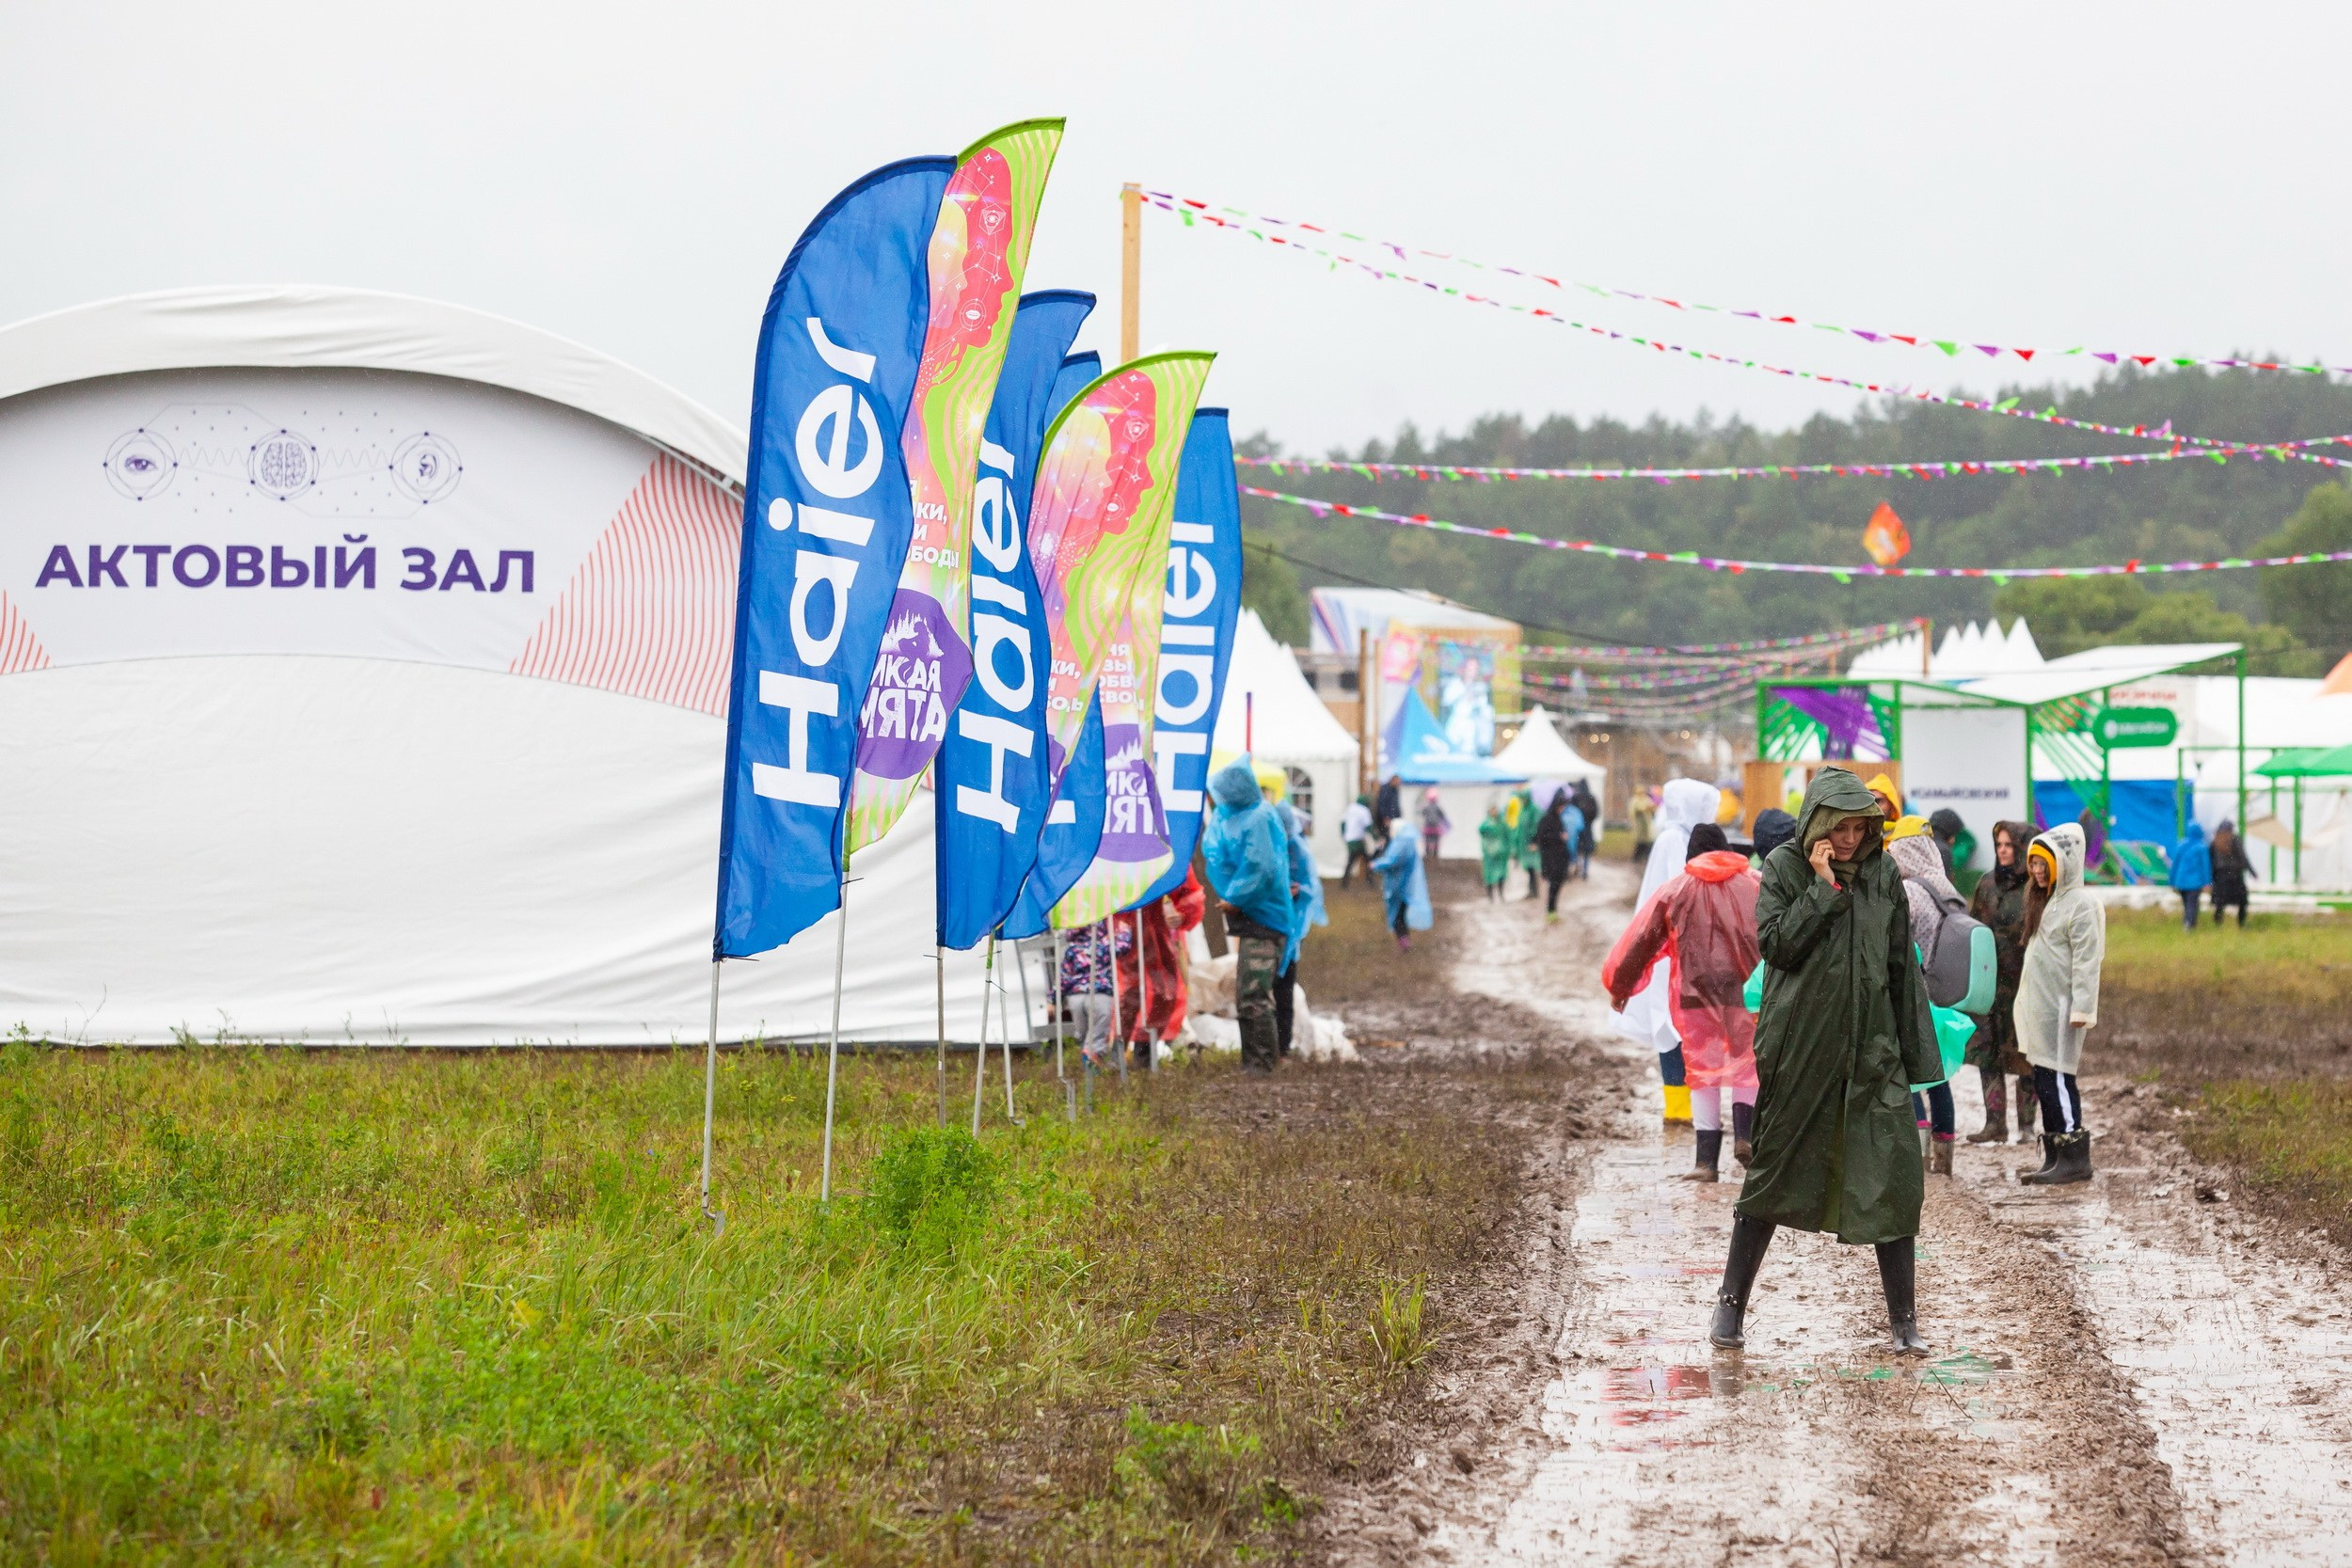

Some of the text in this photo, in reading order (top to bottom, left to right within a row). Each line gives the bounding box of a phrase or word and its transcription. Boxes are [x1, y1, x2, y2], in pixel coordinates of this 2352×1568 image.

[913, 501, 947, 525] КИ,
[35, 534, 534, 594] АКТОВЫЙ ЗАЛ
[753, 317, 884, 808] Haier
[906, 546, 960, 569] БОДЫ
[870, 654, 942, 692] ИКАЯ
